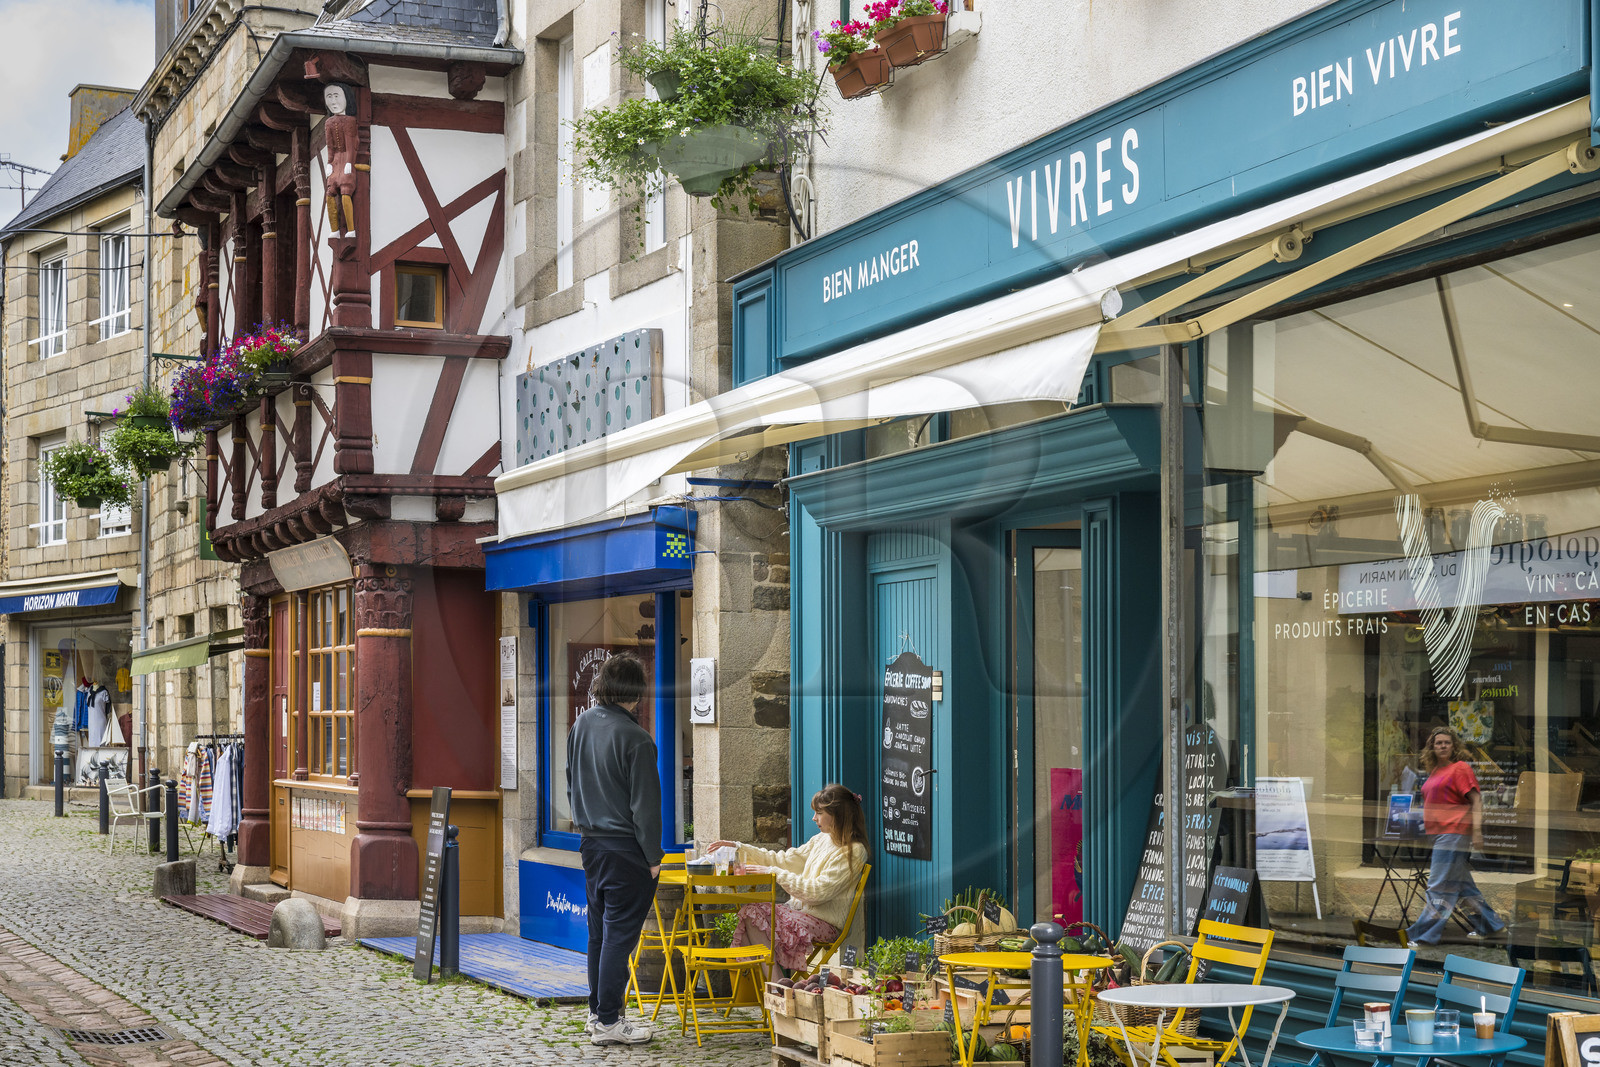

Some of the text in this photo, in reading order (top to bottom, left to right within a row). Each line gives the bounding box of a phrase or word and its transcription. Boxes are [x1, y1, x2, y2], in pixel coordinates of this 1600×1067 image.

[1292, 9, 1463, 118] BIEN VIVRE
[1006, 127, 1141, 250] VIVRES
[822, 239, 920, 305] BIEN MANGER
[1525, 573, 1556, 595] VIN
[23, 591, 80, 611] HORIZON MARIN
[1323, 588, 1389, 610] ÉPICERIE
[1525, 602, 1592, 626] EN-CAS
[1275, 616, 1389, 640] PRODUITS FRAIS
